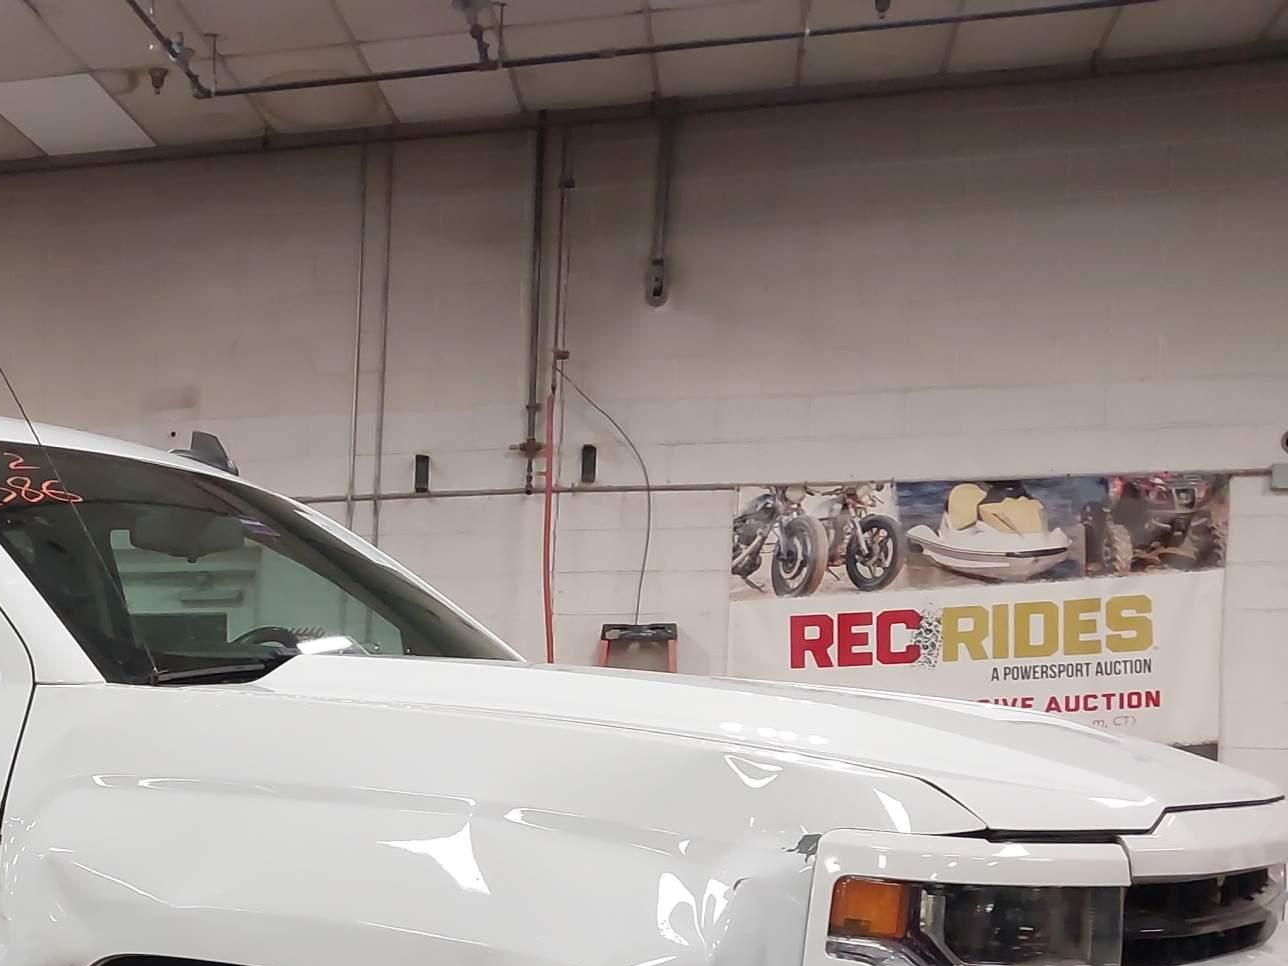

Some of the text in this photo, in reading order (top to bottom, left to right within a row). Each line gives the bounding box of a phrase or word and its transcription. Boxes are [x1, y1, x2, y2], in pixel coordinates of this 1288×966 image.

[789, 594, 1153, 669] REC RIDES
[990, 658, 1152, 682] A POWERSPORT AUCTION
[1045, 690, 1161, 713] AUCTION
